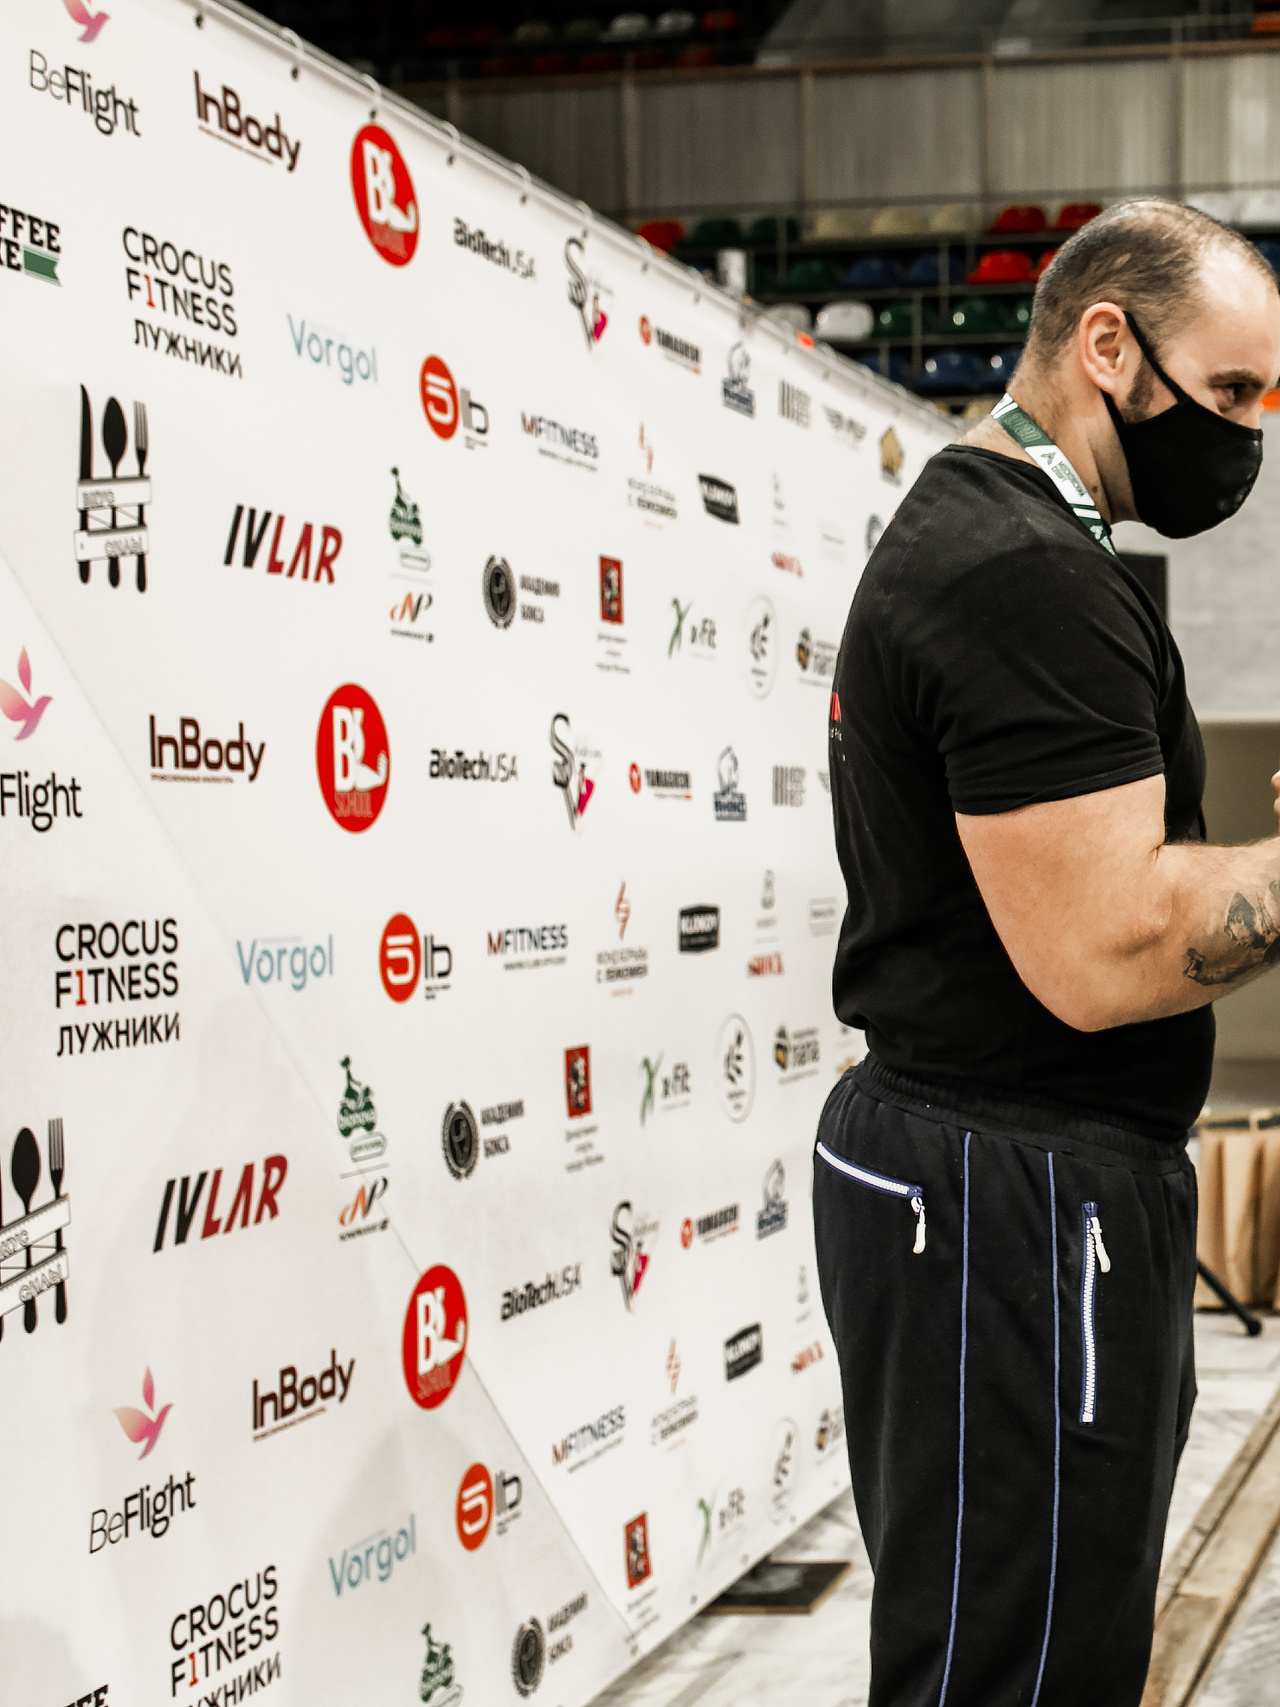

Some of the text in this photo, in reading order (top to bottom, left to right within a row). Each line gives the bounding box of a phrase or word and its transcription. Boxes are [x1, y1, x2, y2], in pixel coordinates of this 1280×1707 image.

[29, 48, 141, 137] BeFlight
[194, 70, 301, 173] InBody
[123, 226, 234, 298] CROCUS
[134, 317, 243, 380] ЛУЖНИКИ
[287, 313, 378, 386] Vorgol
[223, 503, 343, 585] IVLAR
[149, 713, 266, 783] InBody
[55, 917, 178, 962] CROCUS
[235, 934, 333, 992] Vorgol
[56, 1011, 180, 1057] ЛУЖНИКИ
[152, 1153, 289, 1254] IVLAR
[252, 1347, 356, 1431] InBody
[89, 1471, 197, 1555] BeFlight
[328, 1513, 416, 1597] Vorgol
[170, 1564, 278, 1651] CROCUS
